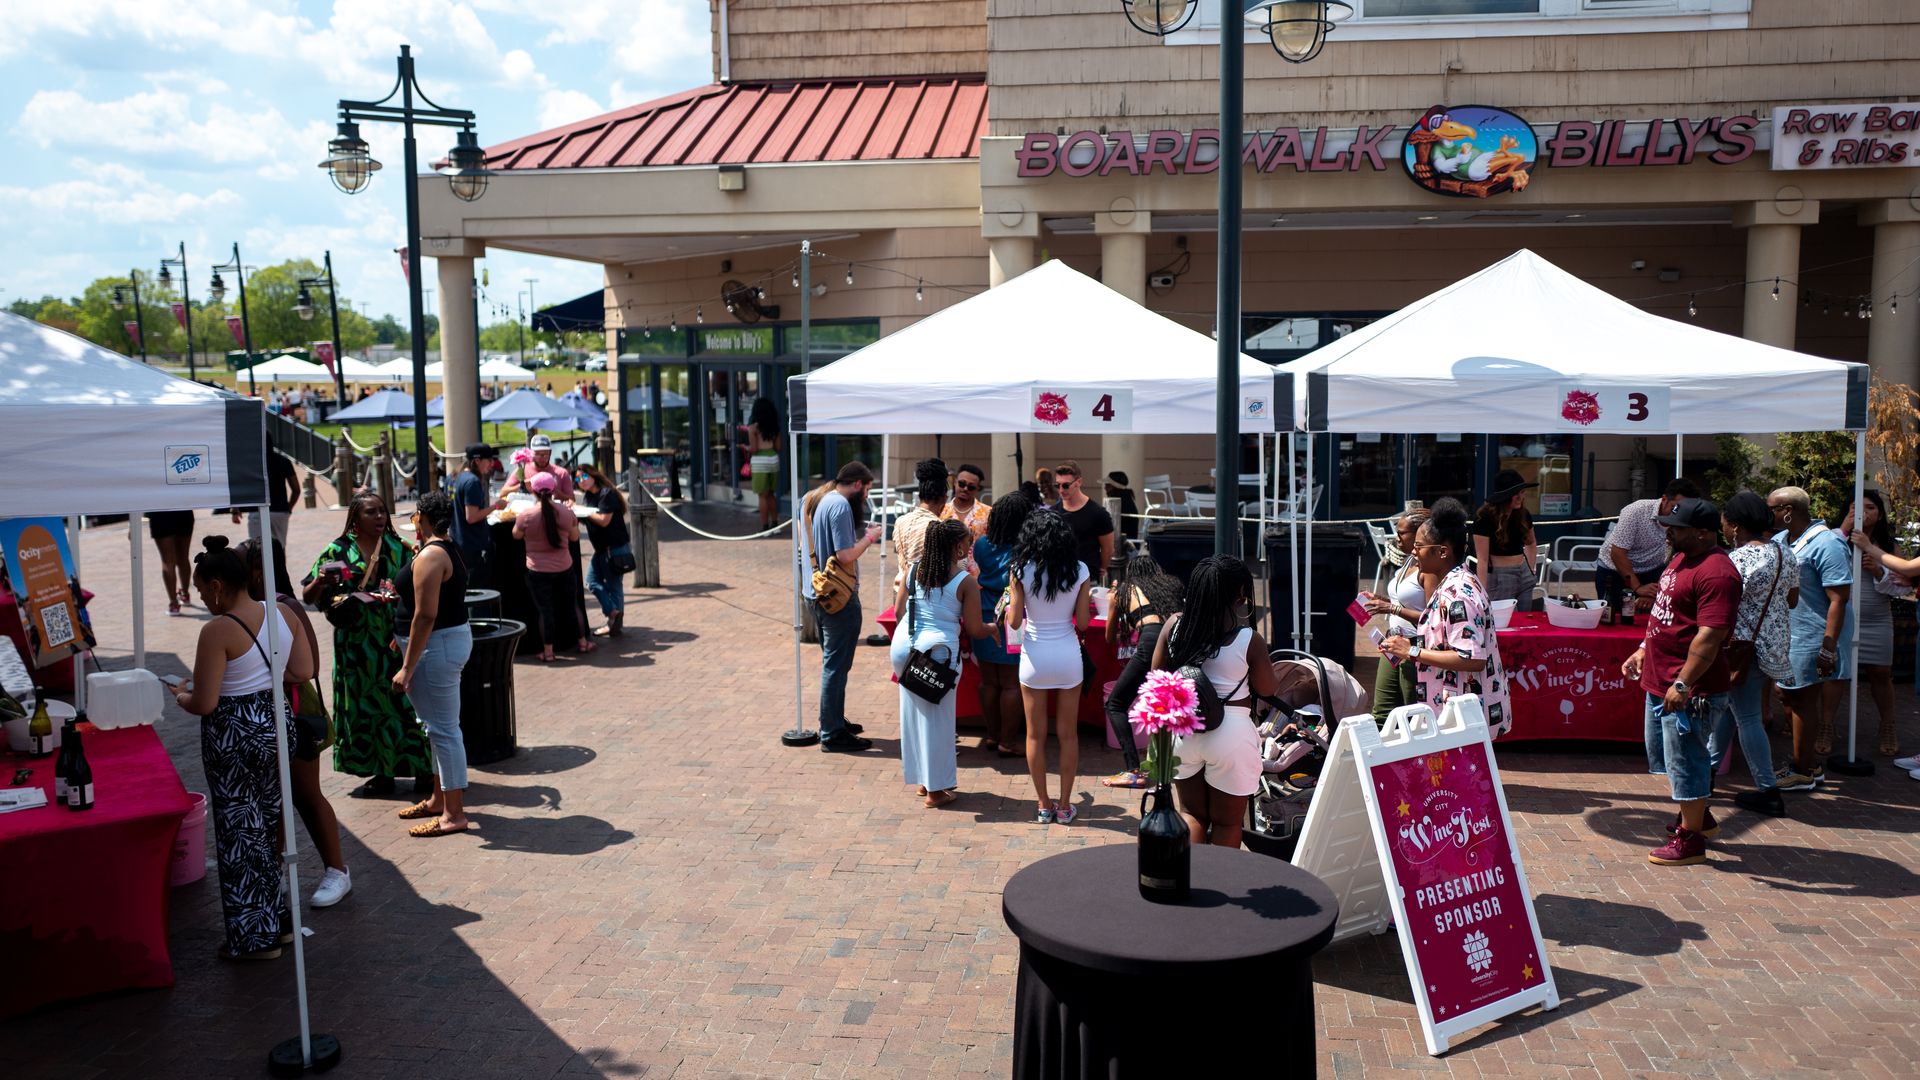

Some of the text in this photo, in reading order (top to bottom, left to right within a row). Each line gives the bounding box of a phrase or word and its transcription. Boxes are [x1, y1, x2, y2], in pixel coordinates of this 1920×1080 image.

[1782, 109, 1858, 134] Raw
[1546, 115, 1761, 168] BILLY'S
[1798, 138, 1909, 165] & Ribs
[1092, 393, 1115, 421] 4
[1626, 392, 1649, 422] 3
[1542, 647, 1592, 659] UNIVERSITY
[910, 665, 929, 681] TOTE
[928, 677, 945, 689] BAG
[923, 666, 938, 678] THE
[1423, 789, 1458, 807] UNIVERSITY
[1434, 802, 1449, 811] CITY
[1416, 866, 1505, 909] PRESENTING
[1434, 896, 1502, 934] SPONSOR
